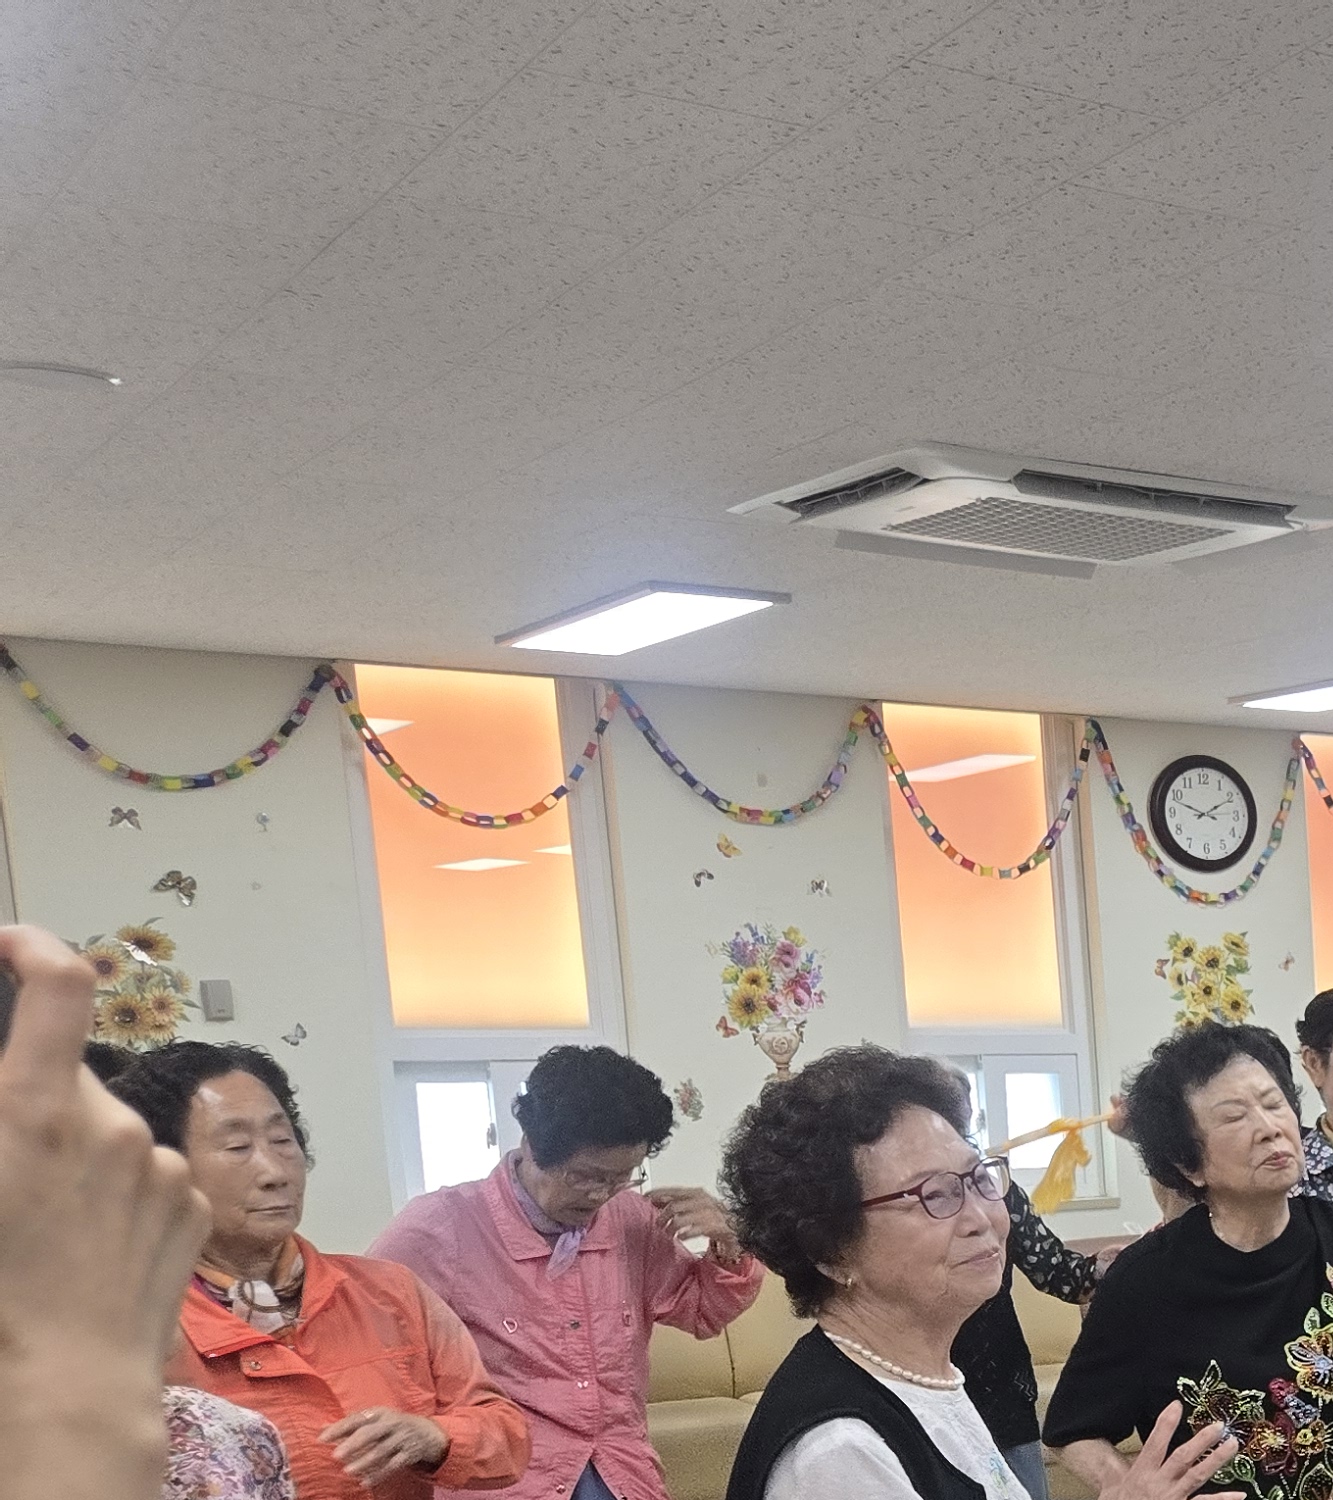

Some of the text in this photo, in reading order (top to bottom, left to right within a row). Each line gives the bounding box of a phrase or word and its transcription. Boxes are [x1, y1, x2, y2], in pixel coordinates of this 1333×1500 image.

[1182, 777, 1192, 789] 11
[1197, 773, 1209, 785] 12
[1217, 779, 1222, 791] 1
[1171, 789, 1183, 801] 10
[1226, 791, 1234, 803] 2
[1168, 807, 1176, 819] 9
[1232, 810, 1240, 822] 3
[1175, 824, 1183, 836] 8
[1228, 827, 1236, 838] 4
[1186, 837, 1192, 849] 7
[1203, 842, 1210, 854] 6
[1220, 839, 1227, 850] 5
